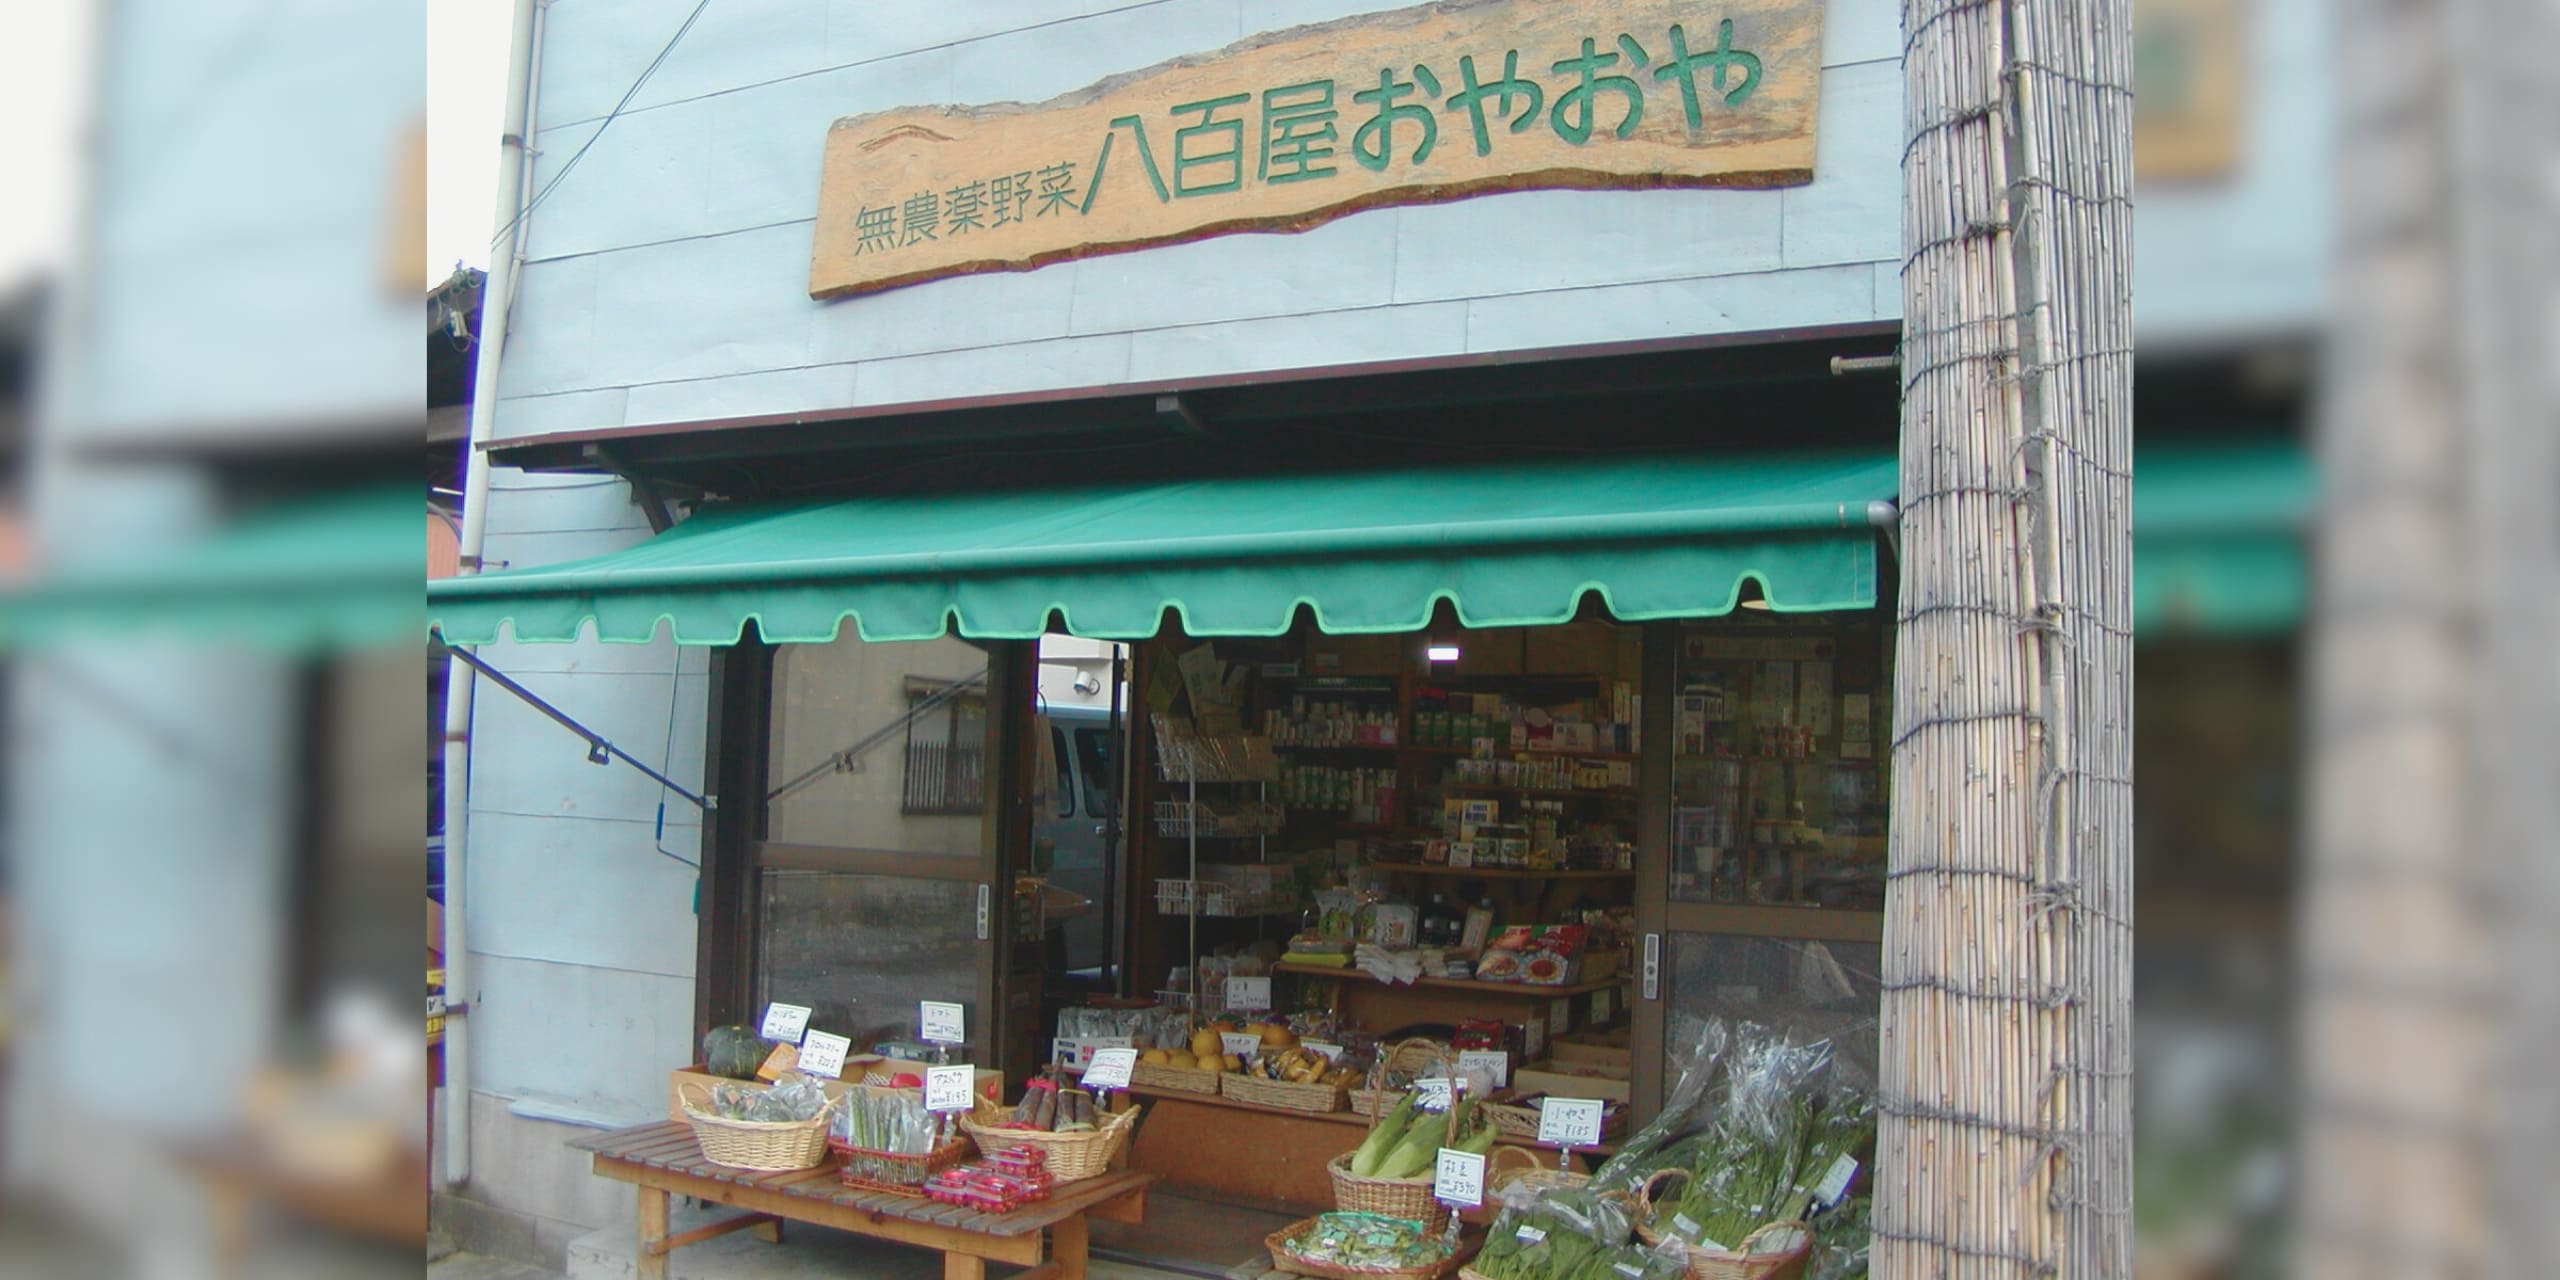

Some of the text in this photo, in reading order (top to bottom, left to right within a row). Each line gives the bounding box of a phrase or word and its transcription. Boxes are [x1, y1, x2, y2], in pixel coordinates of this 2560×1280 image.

[855, 161, 1079, 256] 無農薬野菜
